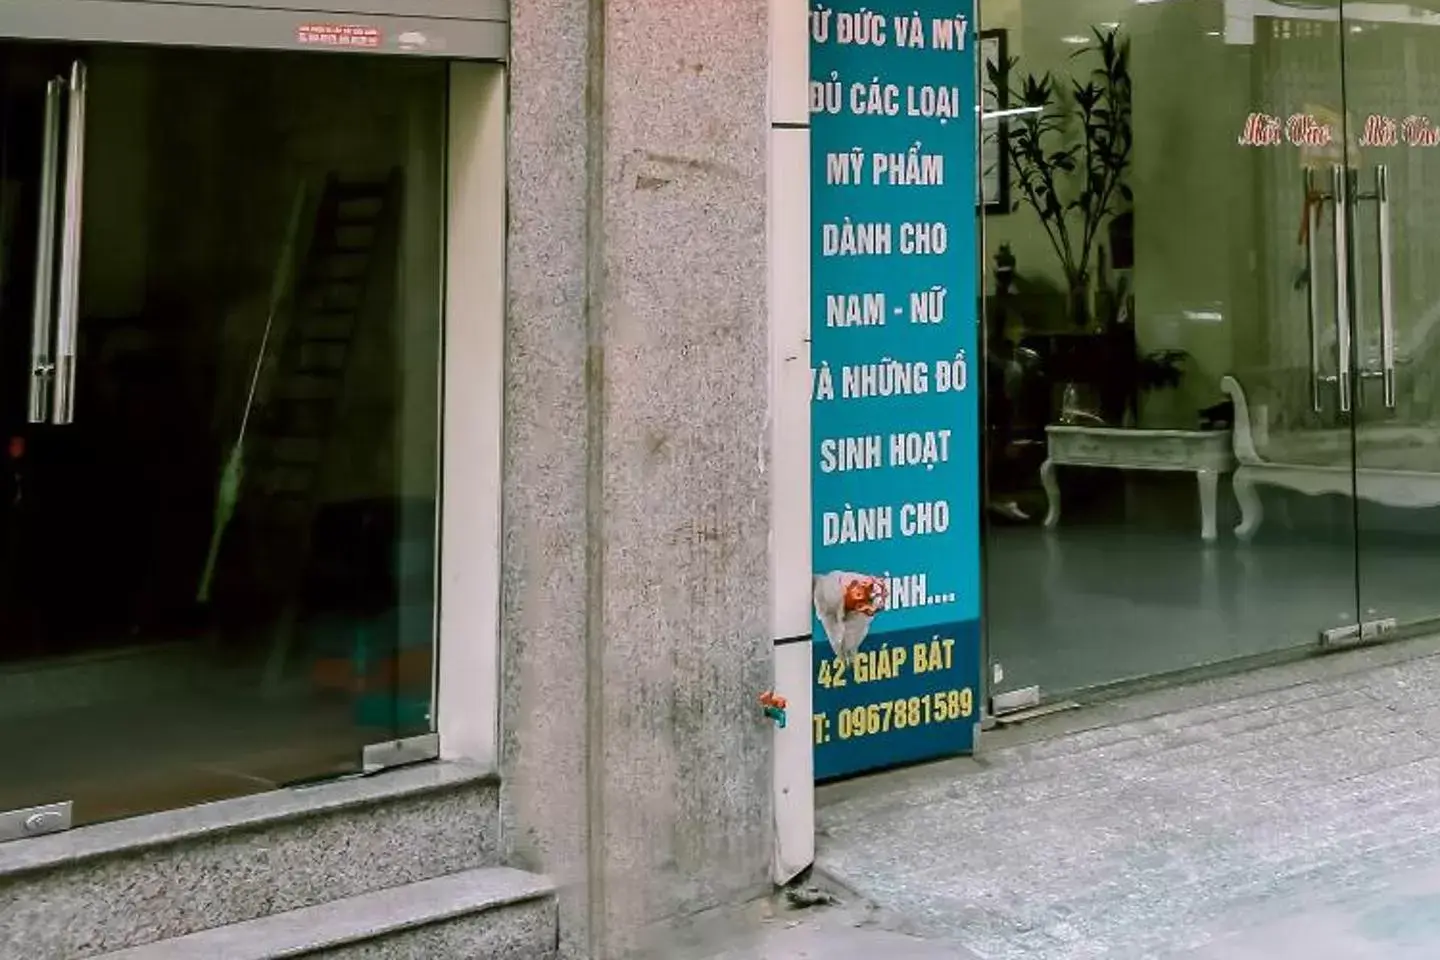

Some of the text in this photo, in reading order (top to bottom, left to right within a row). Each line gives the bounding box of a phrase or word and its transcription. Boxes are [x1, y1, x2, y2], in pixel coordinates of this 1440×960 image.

[809, 3, 968, 51] Ừ ĐỨC VÀ MỸ
[850, 76, 899, 116] CÁC
[907, 86, 959, 125] LOẠI
[827, 141, 944, 185] MỸ PHẨM
[823, 217, 947, 256] DÀNH CHO
[827, 293, 885, 327] NAM
[910, 285, 947, 323] NỮ
[842, 357, 928, 398] NHỮNG
[935, 349, 967, 392] ĐỒ
[820, 430, 951, 473] SINH HOẠT
[823, 500, 949, 546] DÀNH CHO
[818, 635, 955, 688] 42 GIÁP BÁT
[838, 687, 972, 739] 0967881589
